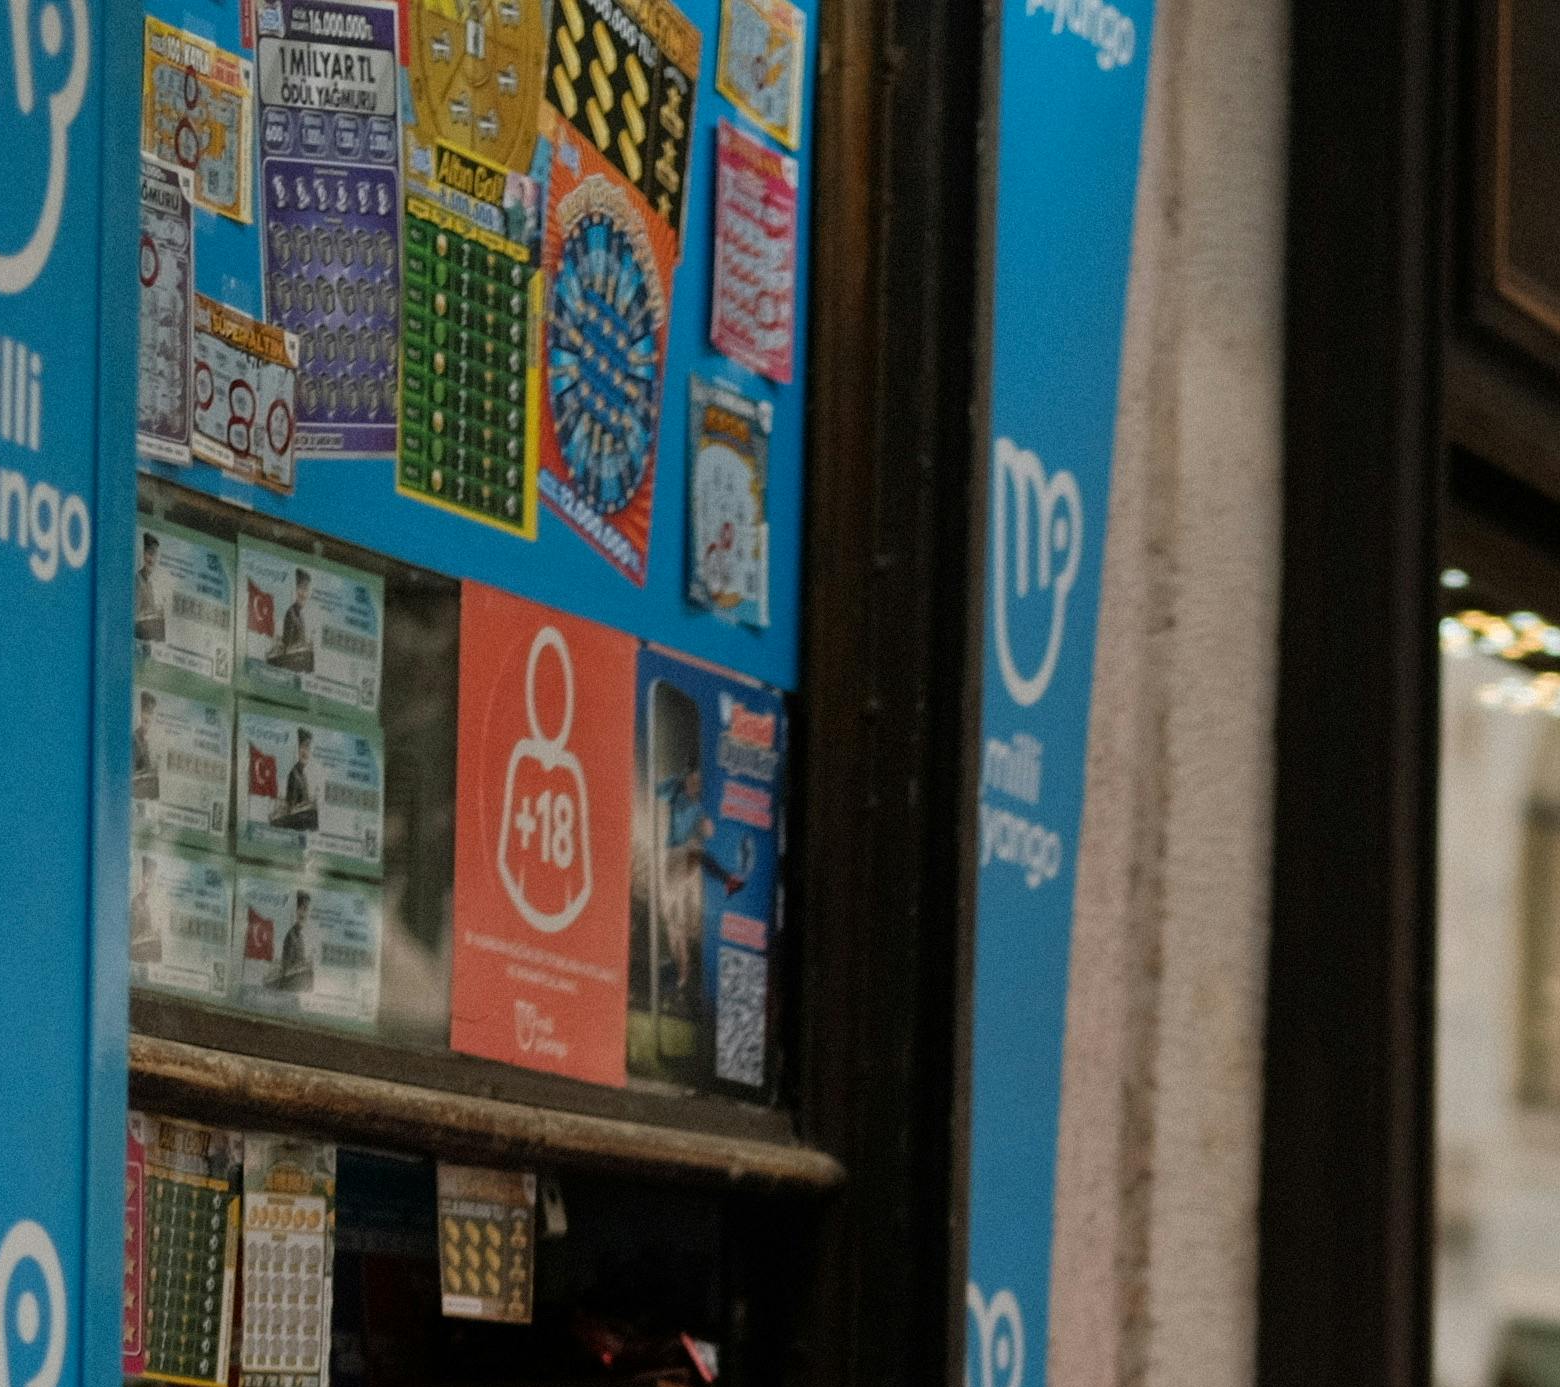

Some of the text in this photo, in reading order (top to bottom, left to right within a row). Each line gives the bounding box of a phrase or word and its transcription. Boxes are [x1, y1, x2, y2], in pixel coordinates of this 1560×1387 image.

[289, 45, 355, 80] MİLYAR
[357, 55, 376, 83] TL
[280, 79, 317, 105] ÖDÜL
[515, 789, 576, 870] +18
